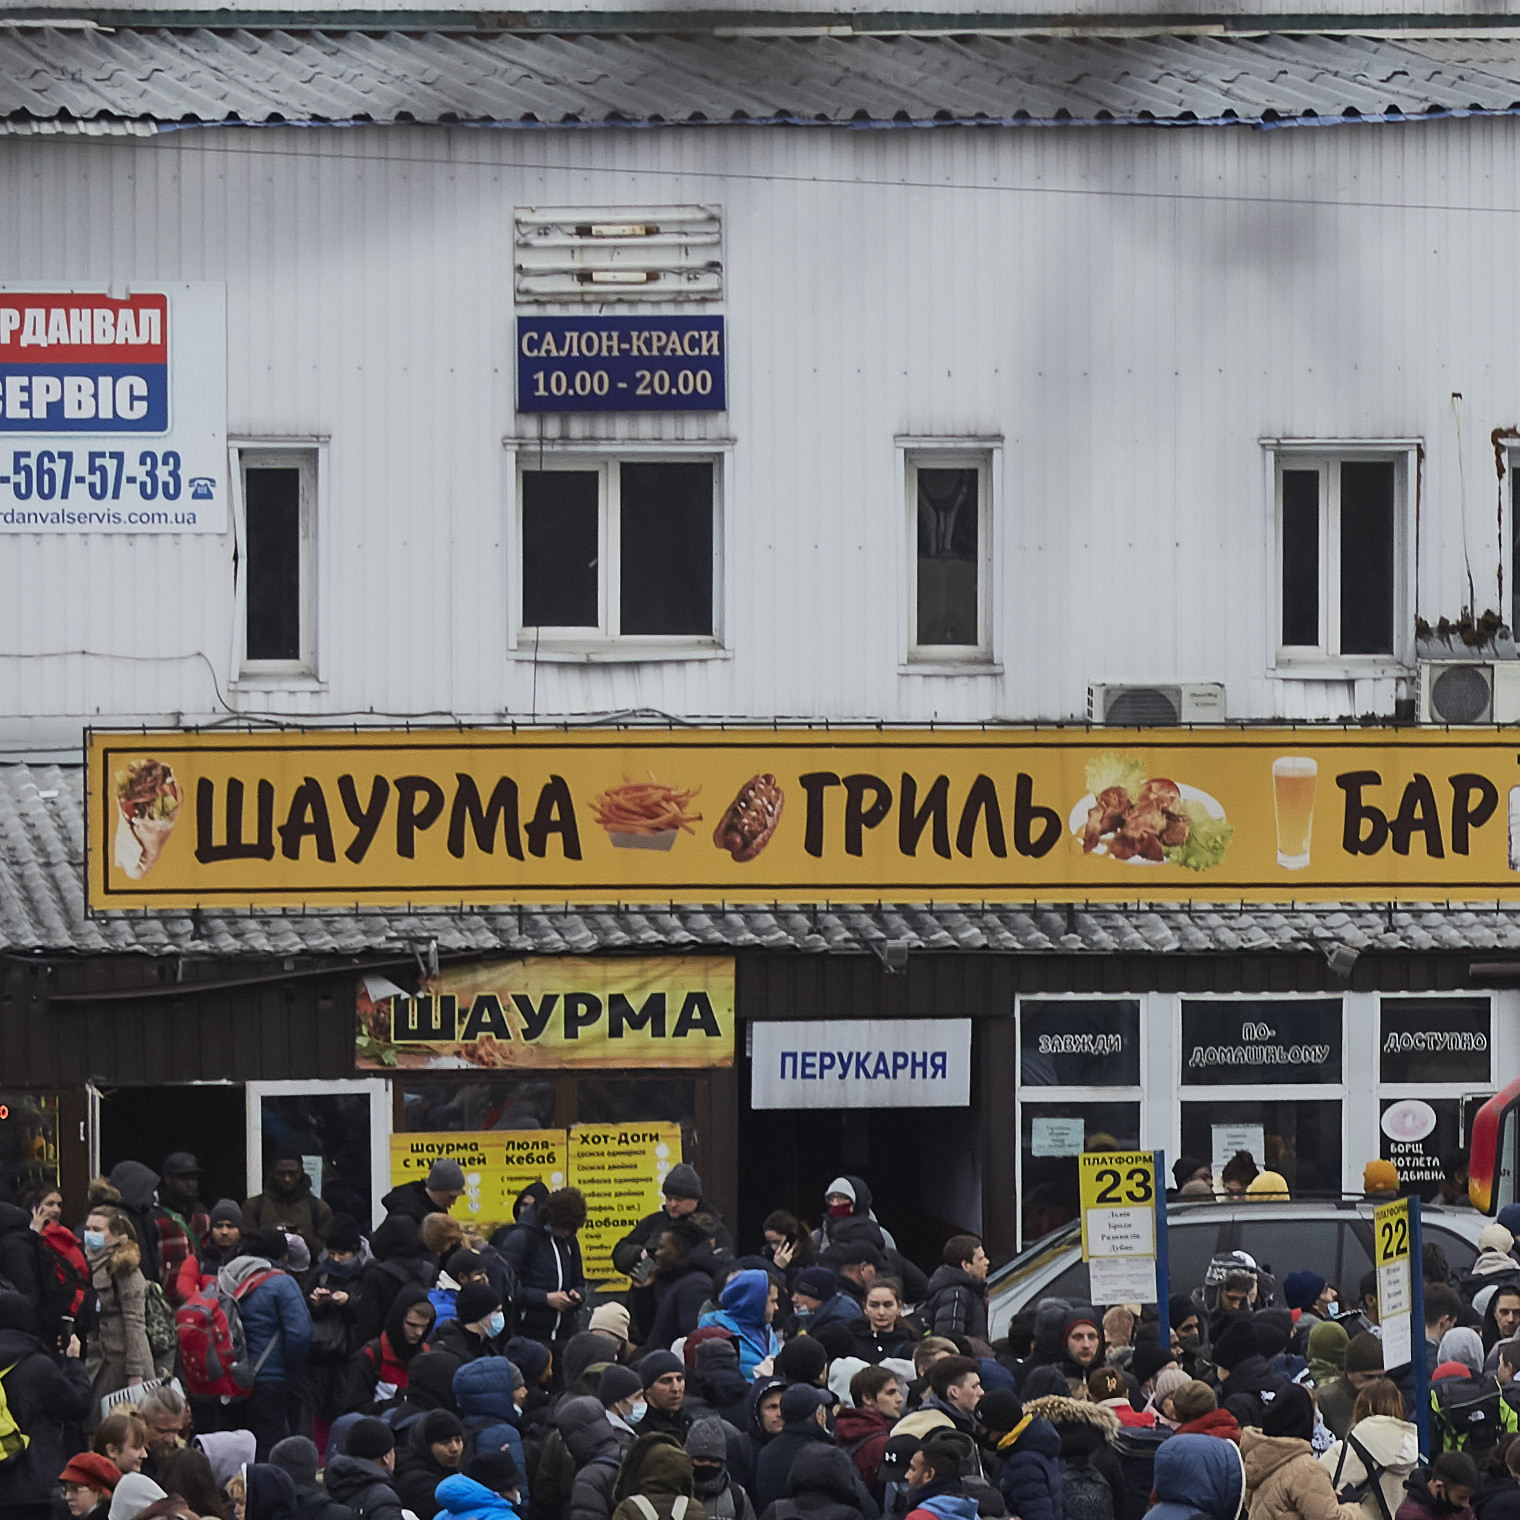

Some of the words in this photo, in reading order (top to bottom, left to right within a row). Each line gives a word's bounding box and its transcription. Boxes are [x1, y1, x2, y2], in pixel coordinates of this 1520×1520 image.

[521, 330, 720, 357] САЛОН-КРАСИ
[533, 370, 610, 396] 10.00
[635, 369, 713, 396] 20.00
[0, 375, 149, 420] ЕРВІС
[194, 773, 584, 864] ШАУРМА
[799, 772, 1063, 862] ГРИЛЬ
[1336, 769, 1500, 857] БАР
[391, 991, 723, 1042] ШАУРМА
[1038, 1033, 1122, 1055] ЗАВЖДИ
[1383, 1031, 1488, 1053] ДОСТУПНО
[1188, 1045, 1331, 1068] ДОМАШНЬОМУ
[779, 1050, 948, 1080] ПЕРУКАРНЯ
[410, 1141, 480, 1155] Шаурма
[416, 1152, 487, 1169] куцей
[1083, 1155, 1154, 1166] ПЛАТФОРМ
[1390, 1143, 1424, 1155] БОРЩ
[1095, 1168, 1153, 1204] 23
[1381, 1217, 1408, 1261] 22
